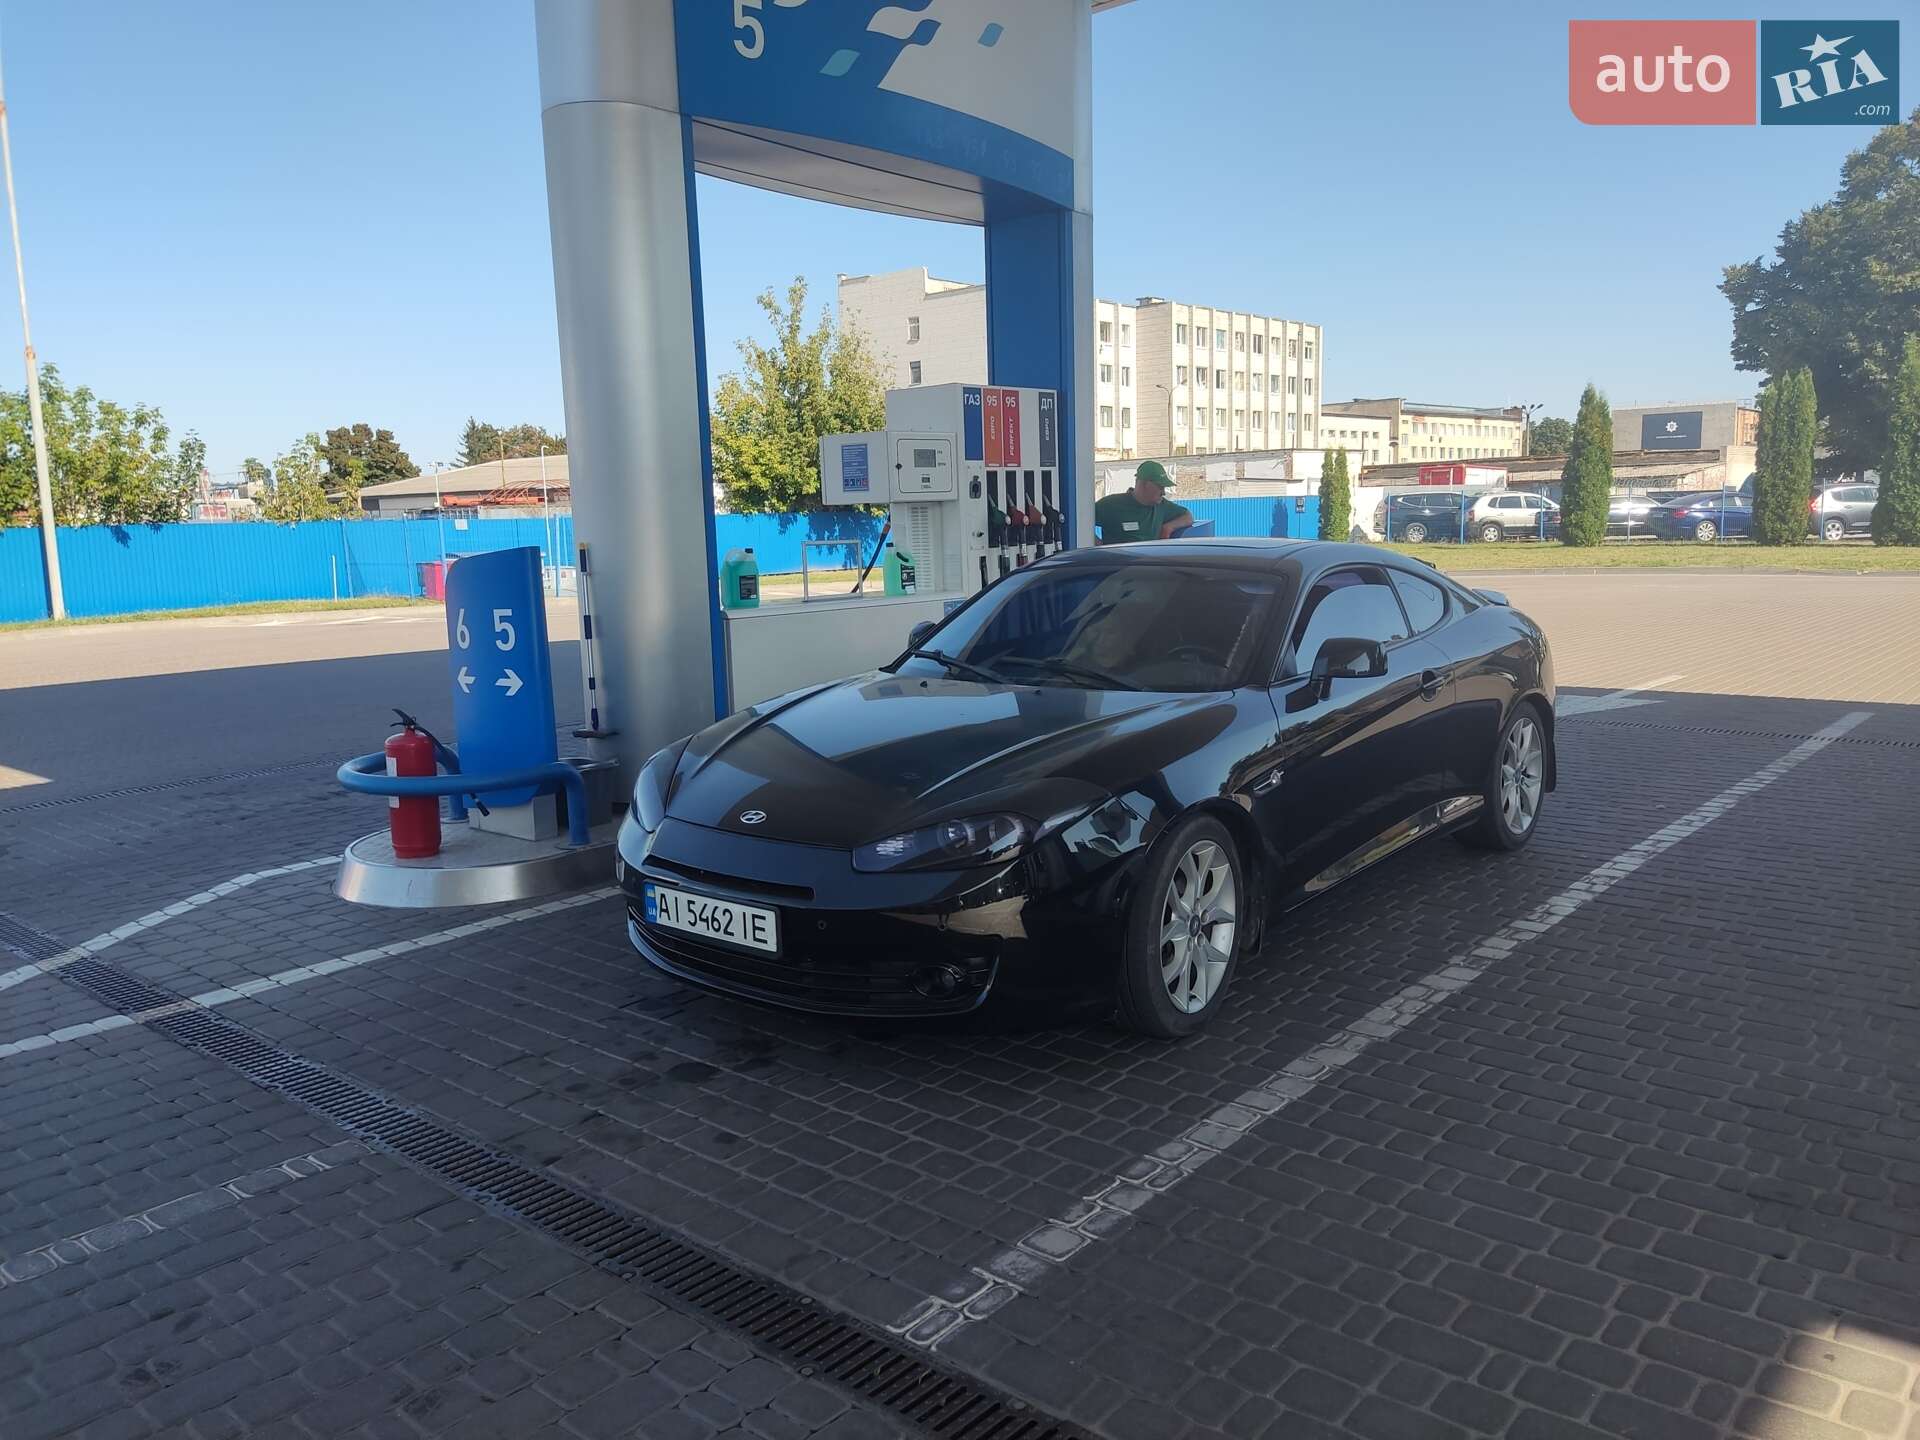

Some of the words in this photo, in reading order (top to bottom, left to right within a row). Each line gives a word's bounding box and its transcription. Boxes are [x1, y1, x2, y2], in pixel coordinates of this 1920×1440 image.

[733, 0, 765, 59] 5
[964, 393, 981, 406] ГАЗ
[986, 395, 998, 407] 95
[1005, 396, 1016, 408] 95
[1040, 398, 1053, 410] ДП
[456, 608, 471, 650] 6
[493, 608, 516, 652] 5
[659, 893, 680, 923] AI
[686, 899, 735, 937] 5462
[742, 911, 769, 945] IE
